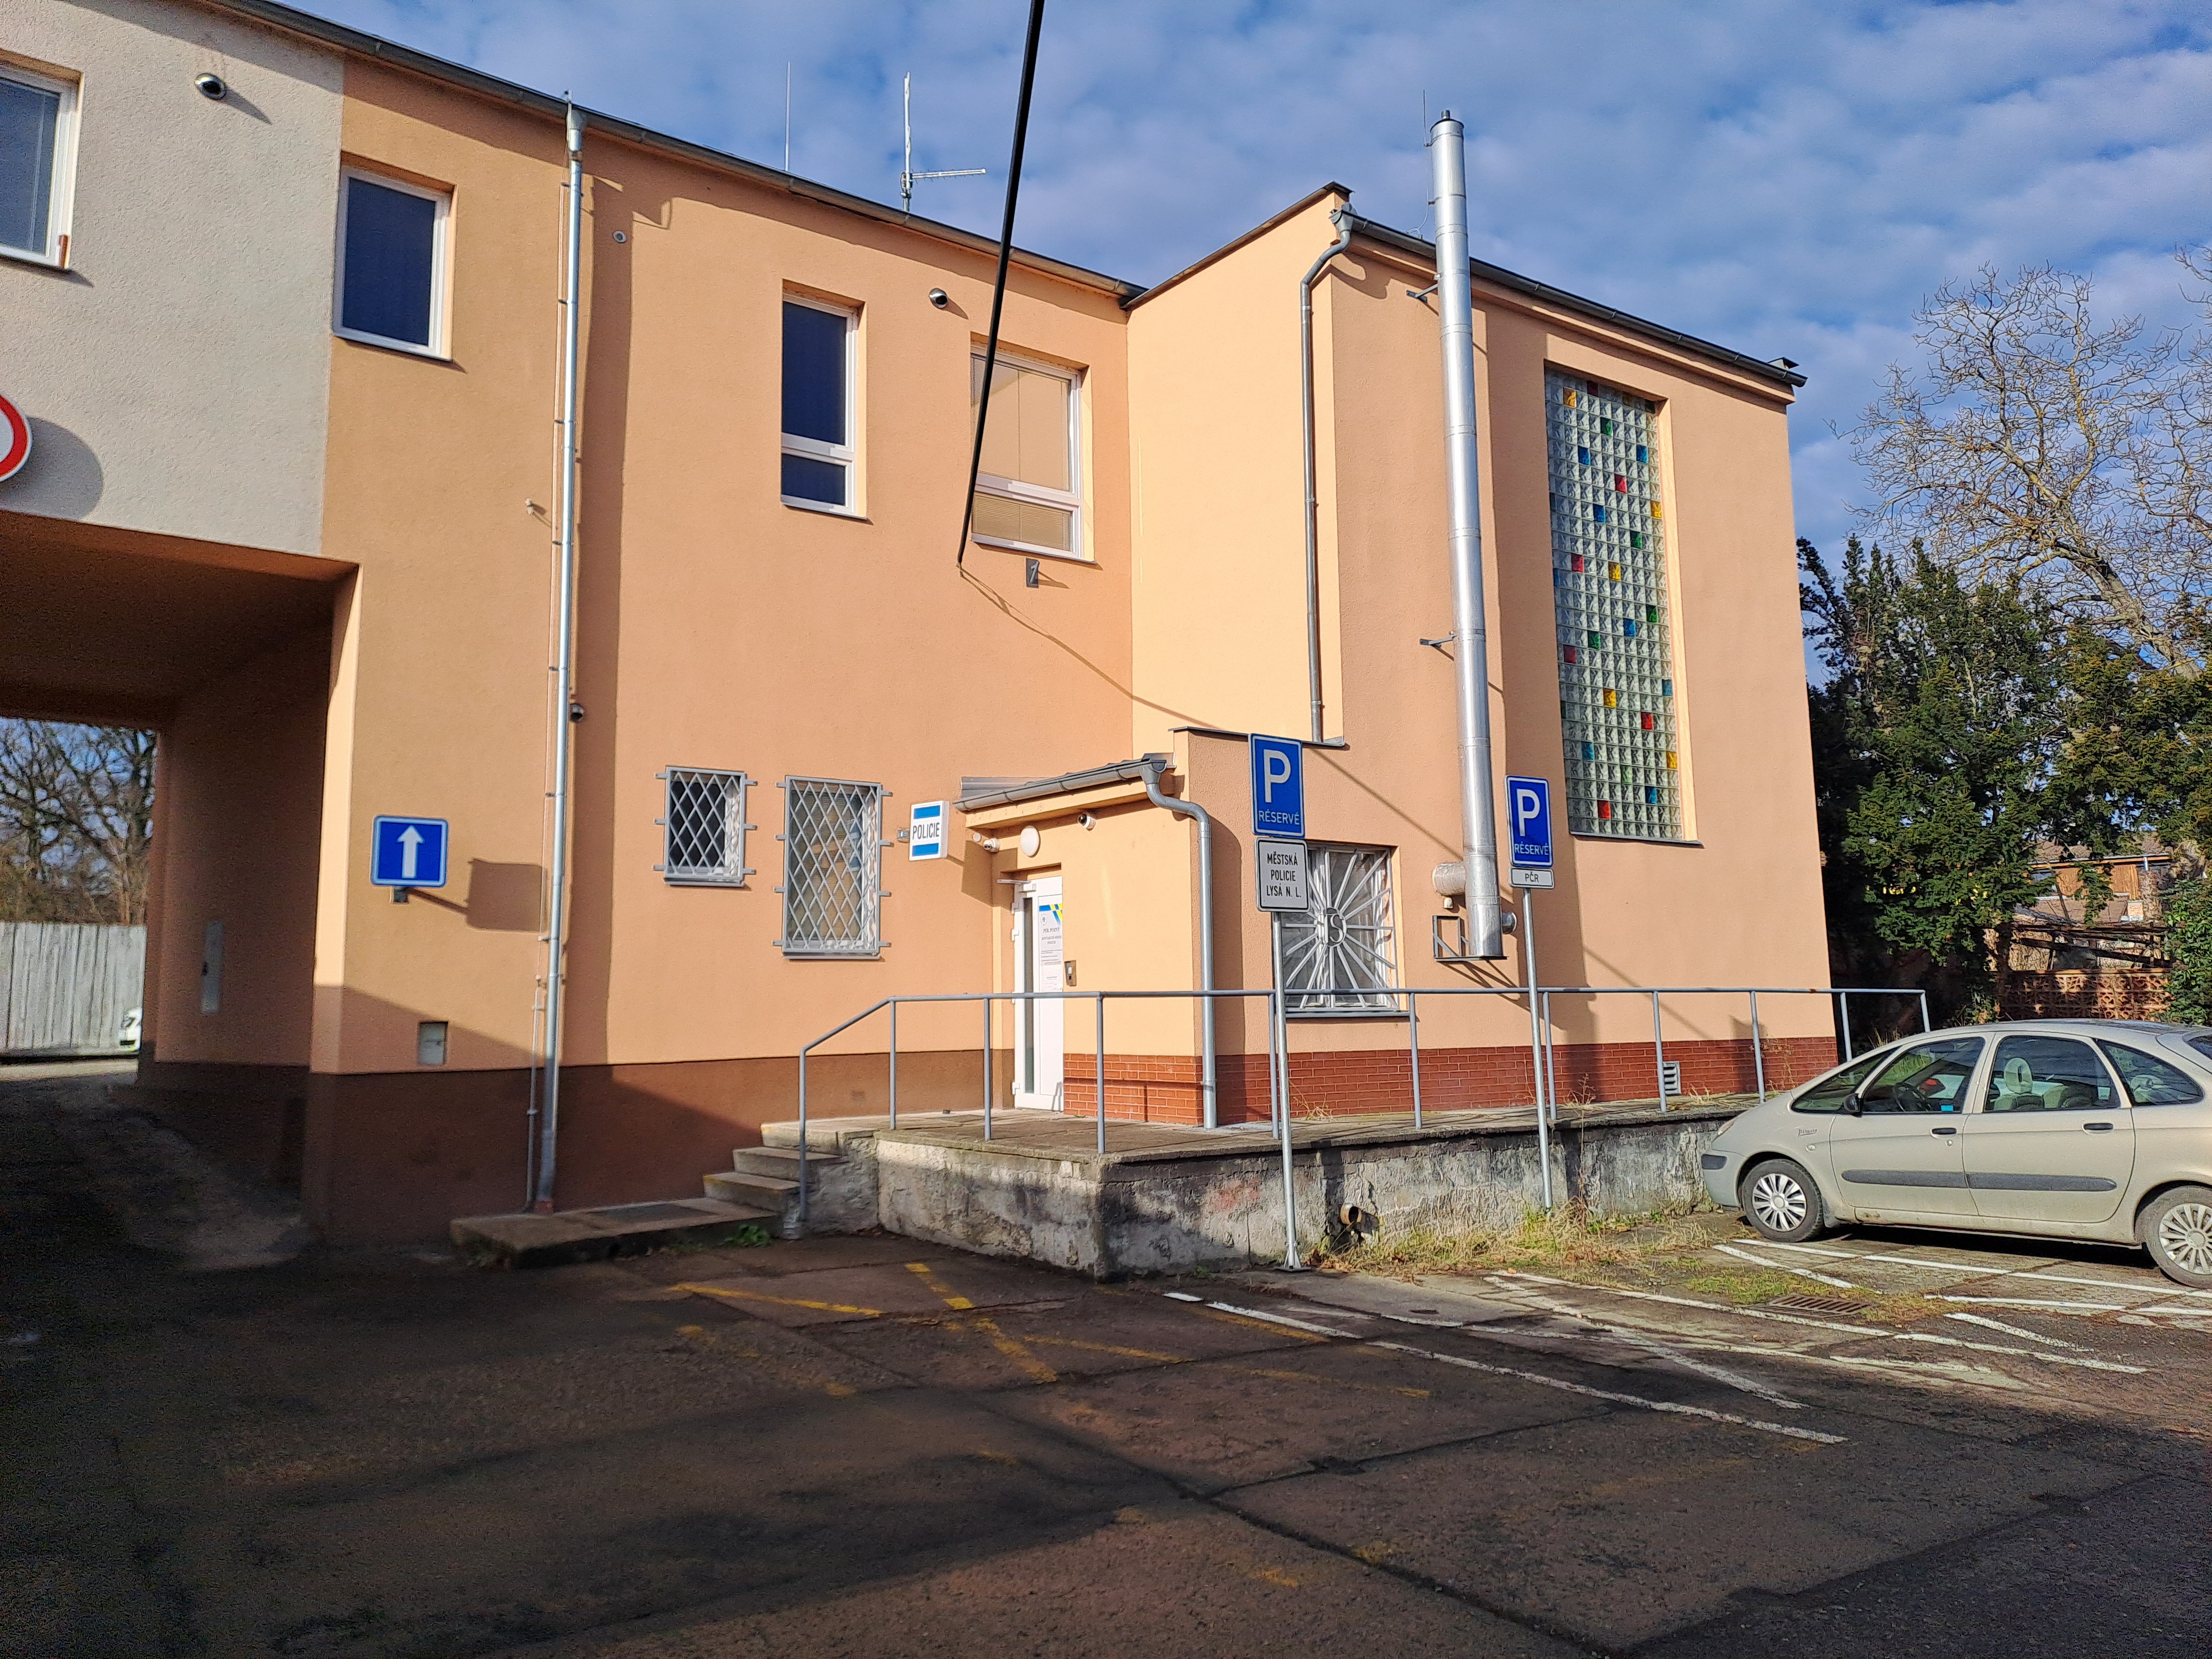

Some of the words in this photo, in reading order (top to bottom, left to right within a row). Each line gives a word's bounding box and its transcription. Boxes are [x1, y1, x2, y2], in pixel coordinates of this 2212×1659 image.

[1030, 561, 1039, 583] 1
[1264, 749, 1291, 803] P
[1258, 808, 1300, 825] RÉSERVÉ
[1516, 788, 1540, 837] P
[912, 822, 940, 840] POLICIE
[1514, 841, 1549, 855] RÉSERVÉ
[1267, 851, 1298, 866] MĚSTSKÁ
[1271, 869, 1296, 881] POLICIE
[1525, 871, 1539, 883] PČR
[1266, 883, 1283, 897] LYSÁ
[1286, 886, 1293, 897] N.
[1295, 886, 1302, 898] L.
